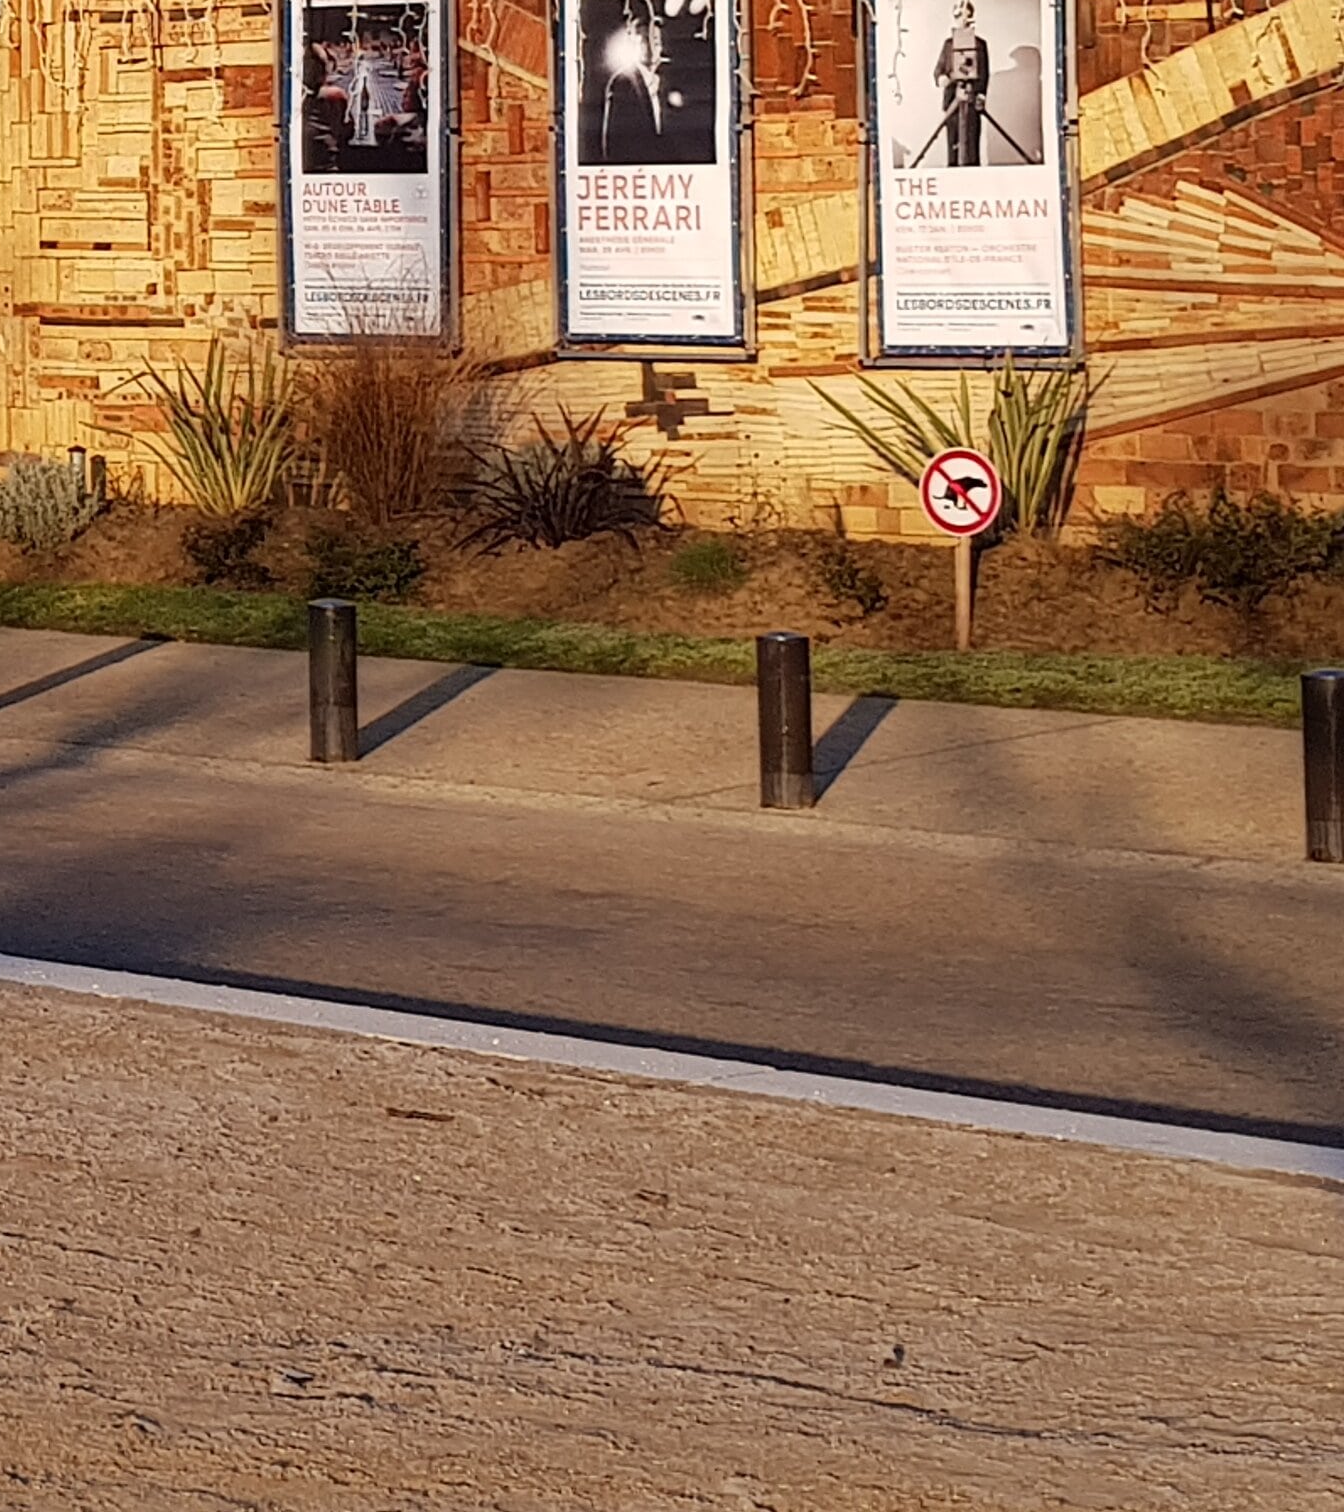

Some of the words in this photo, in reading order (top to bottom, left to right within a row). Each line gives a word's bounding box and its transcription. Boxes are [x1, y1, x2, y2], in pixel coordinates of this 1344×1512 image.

[303, 182, 367, 196] AUTOUR
[576, 168, 693, 200] JÉRÉMY
[895, 177, 938, 196] THE
[303, 199, 348, 214] D'UNE
[354, 199, 402, 214] TABLE
[895, 199, 1048, 220] CAMERAMAN
[577, 205, 701, 231] FERRARI
